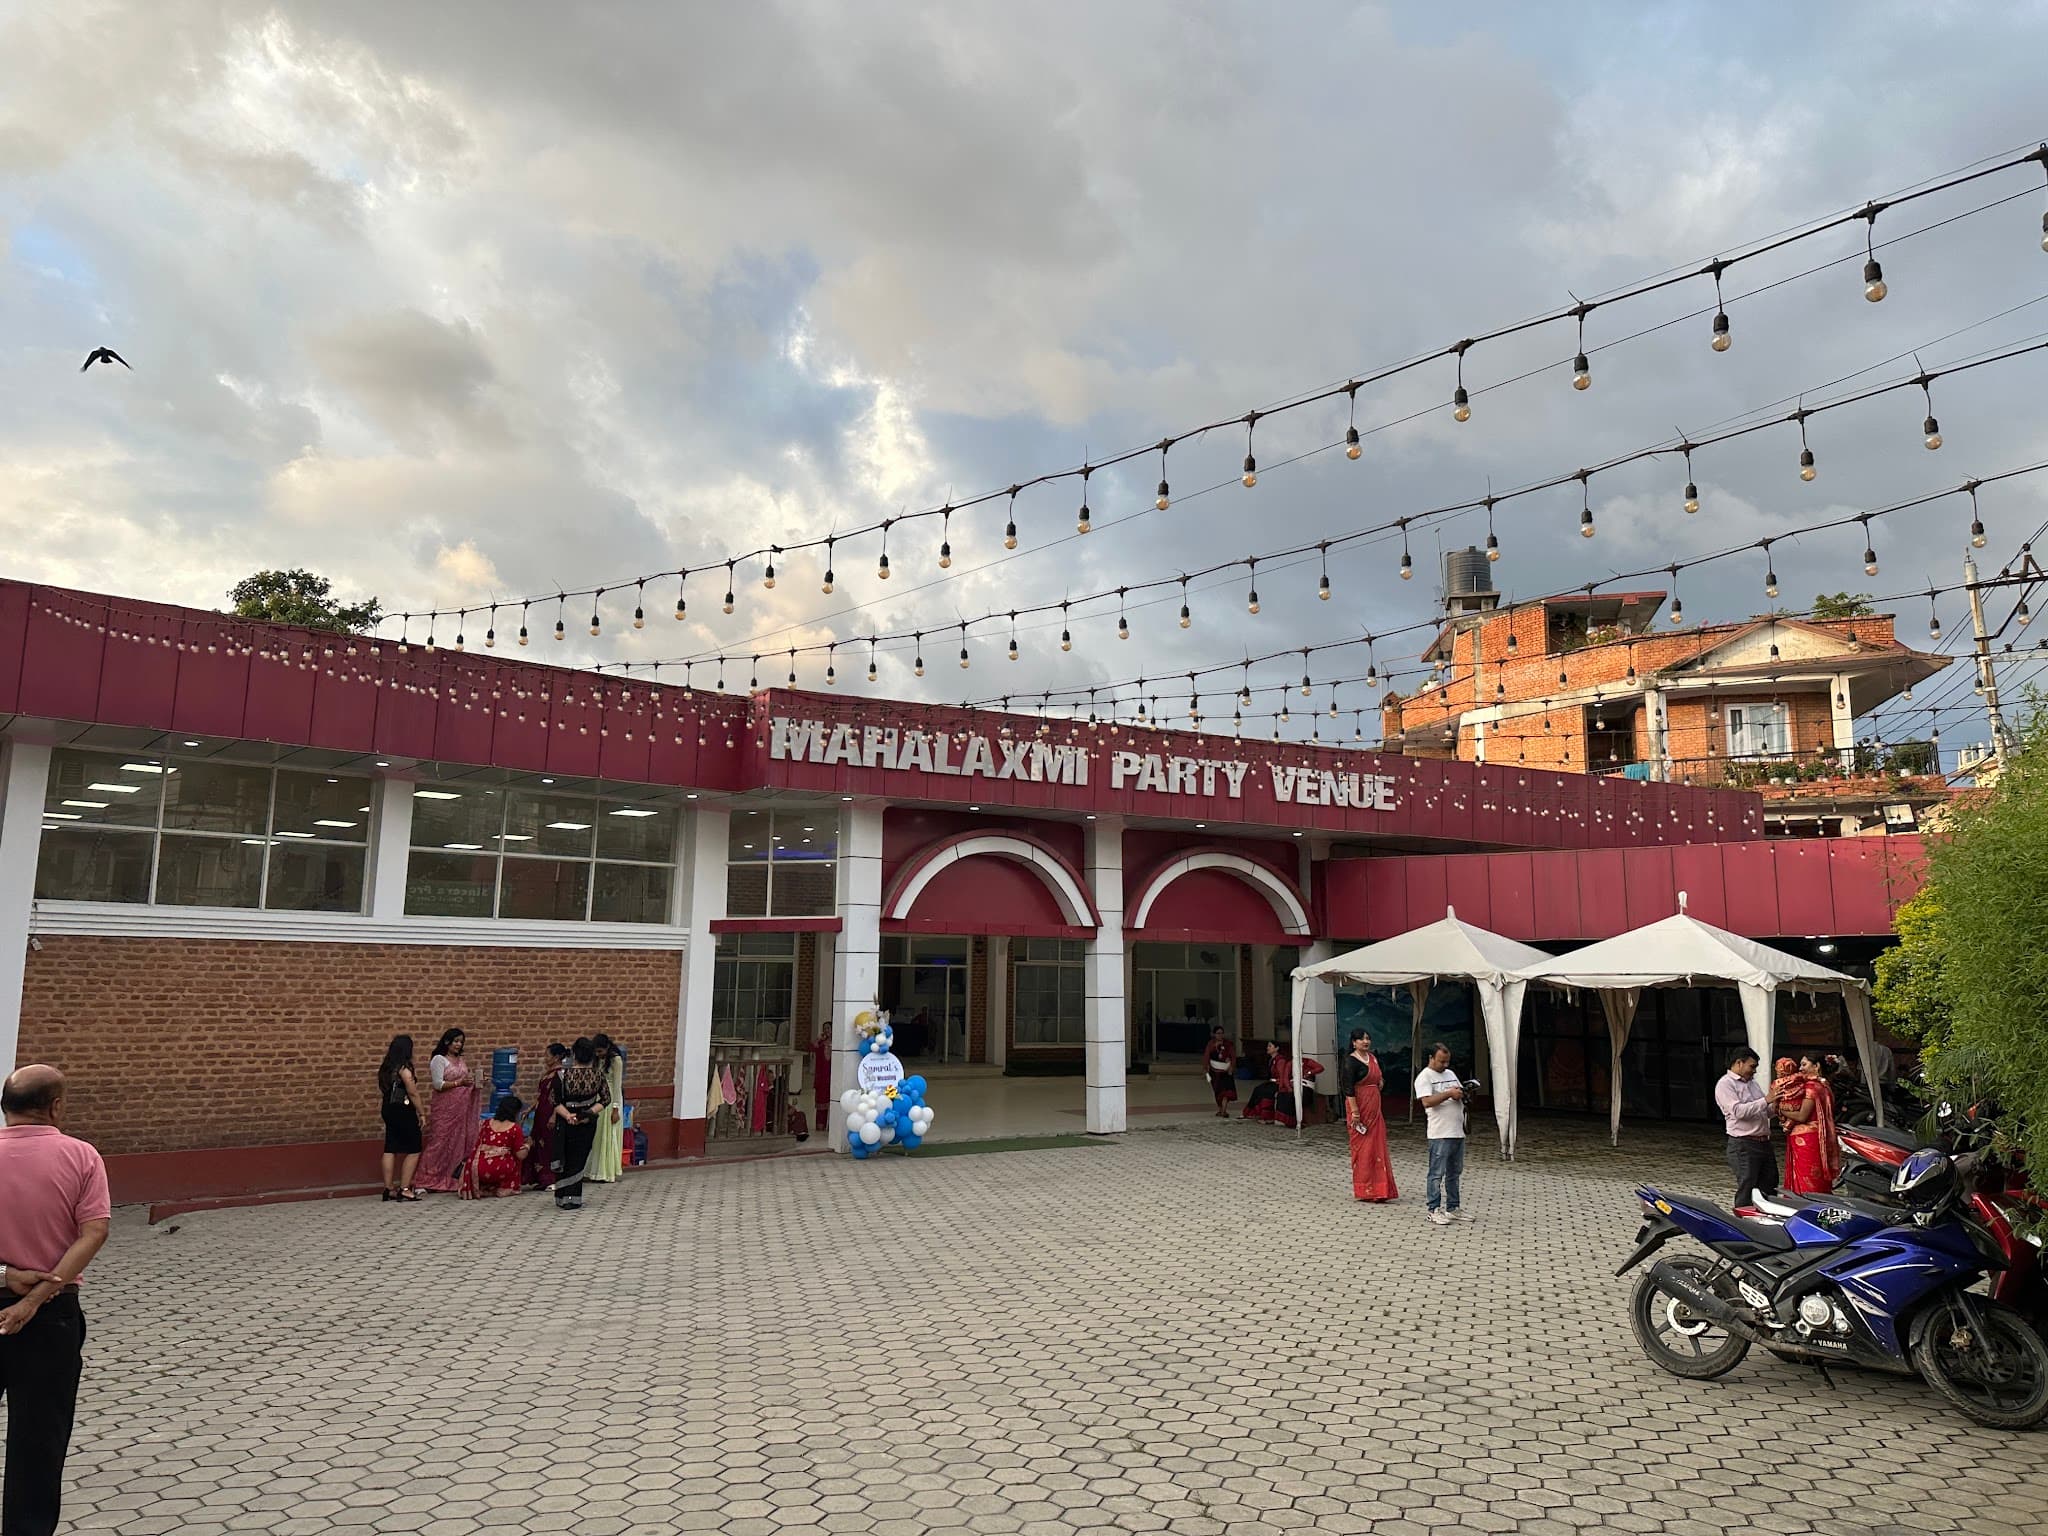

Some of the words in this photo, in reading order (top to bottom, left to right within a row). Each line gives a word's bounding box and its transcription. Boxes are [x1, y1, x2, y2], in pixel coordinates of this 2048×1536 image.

[769, 716, 1089, 786] MAHALAXMI
[1111, 750, 1249, 799] PARTY
[1270, 764, 1397, 812] VENUE
[1818, 1339, 1848, 1351] YAMAHA
